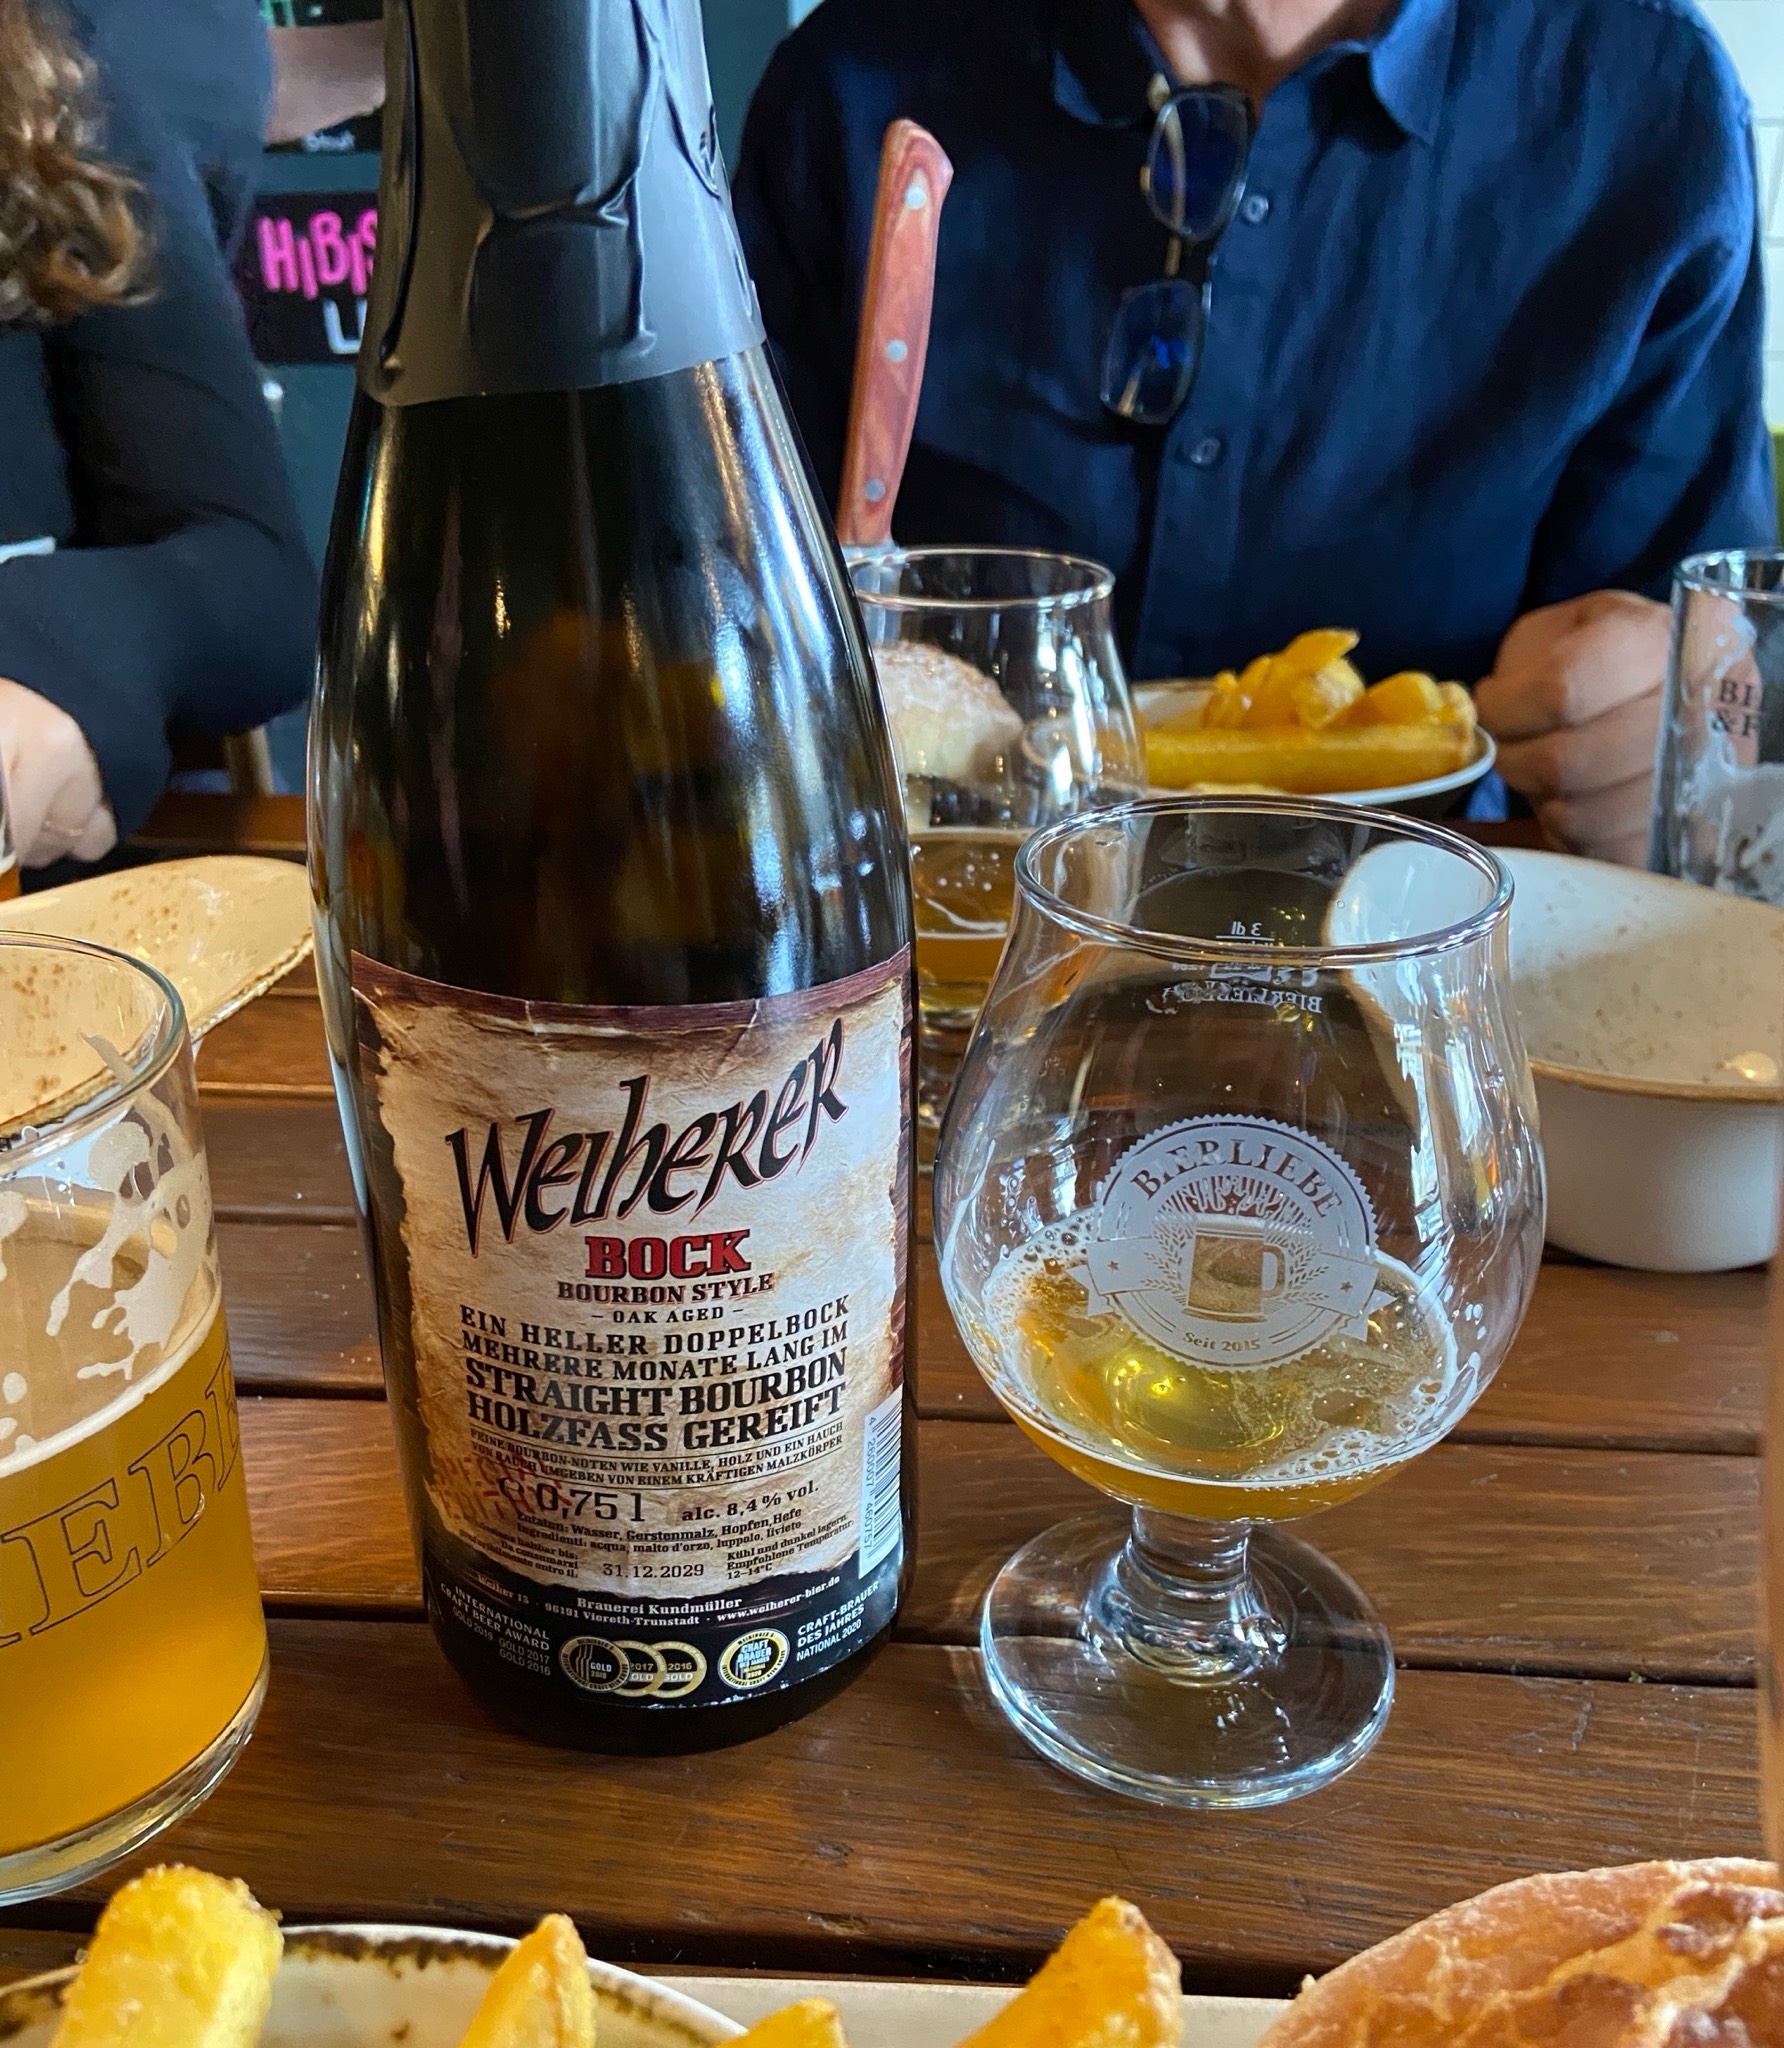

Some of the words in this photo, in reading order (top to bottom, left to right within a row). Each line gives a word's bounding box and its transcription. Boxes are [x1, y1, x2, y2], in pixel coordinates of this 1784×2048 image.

[1130, 1138, 1343, 1218] BIERLIEBE
[585, 1229, 751, 1281] BOCK
[557, 1280, 686, 1305] BOURBON
[692, 1273, 775, 1304] STYLE
[460, 1304, 506, 1337] EIN
[521, 1322, 650, 1355] HELLER
[663, 1294, 850, 1355] DOPPELBOCK
[613, 1309, 659, 1324] OAK
[666, 1305, 725, 1324] AGED
[460, 1329, 612, 1380] MEHRERE
[612, 1354, 738, 1381] MONATE
[746, 1334, 815, 1372] LANG
[822, 1320, 849, 1351] IM
[1183, 1331, 1218, 1350] Seit
[1220, 1338, 1261, 1352] 2015
[466, 1357, 676, 1417] STRAIGHT
[679, 1347, 848, 1417] BOURBON
[467, 1389, 669, 1452] HOLZFASS
[682, 1382, 848, 1451] GEREIFT
[541, 1462, 605, 1484] UMGEBEN
[607, 1474, 635, 1485] VON
[637, 1472, 683, 1486] EINEM
[685, 1462, 765, 1485] KRÄFTIGEN
[766, 1434, 843, 1471] MALZKÖRPER
[620, 1461, 649, 1473] WIE
[652, 1459, 715, 1474] VANILLE,
[718, 1450, 753, 1469] HOLZ
[756, 1445, 782, 1460] UND
[784, 1440, 805, 1453] EIN
[807, 1421, 843, 1445] HAUCH
[865, 1438, 877, 1487] 260007
[536, 1483, 618, 1521] 0,75
[681, 1502, 721, 1522] alc.
[787, 1480, 819, 1501] vol.
[863, 1501, 874, 1549] 460757
[571, 1523, 623, 1541] Wasser,
[626, 1527, 718, 1543] Gerstenmalz,
[633, 1542, 670, 1553] malto
[602, 1563, 705, 1579] 31.12.2029
[440, 1583, 470, 1614] CRAFT
[472, 1609, 502, 1633] BEER
[504, 1627, 550, 1651] AWARD
[455, 1586, 550, 1641] INTERNATIONAL
[577, 1597, 645, 1614] Brauerei
[648, 1598, 743, 1615] Kundmüller
[583, 1610, 700, 1626] Viereth-Trunstadt
[716, 1574, 841, 1622] www.weiherer-bier.de
[797, 1580, 880, 1636] CRAFT-BRAUER
[796, 1634, 841, 1662] NATIONAL
[841, 1618, 863, 1641] 2020
[797, 1631, 822, 1648] DES
[824, 1603, 866, 1638] JAHRES
[527, 1648, 550, 1665] 2017
[589, 1661, 612, 1673] GOLD
[667, 1661, 693, 1671] 2016
